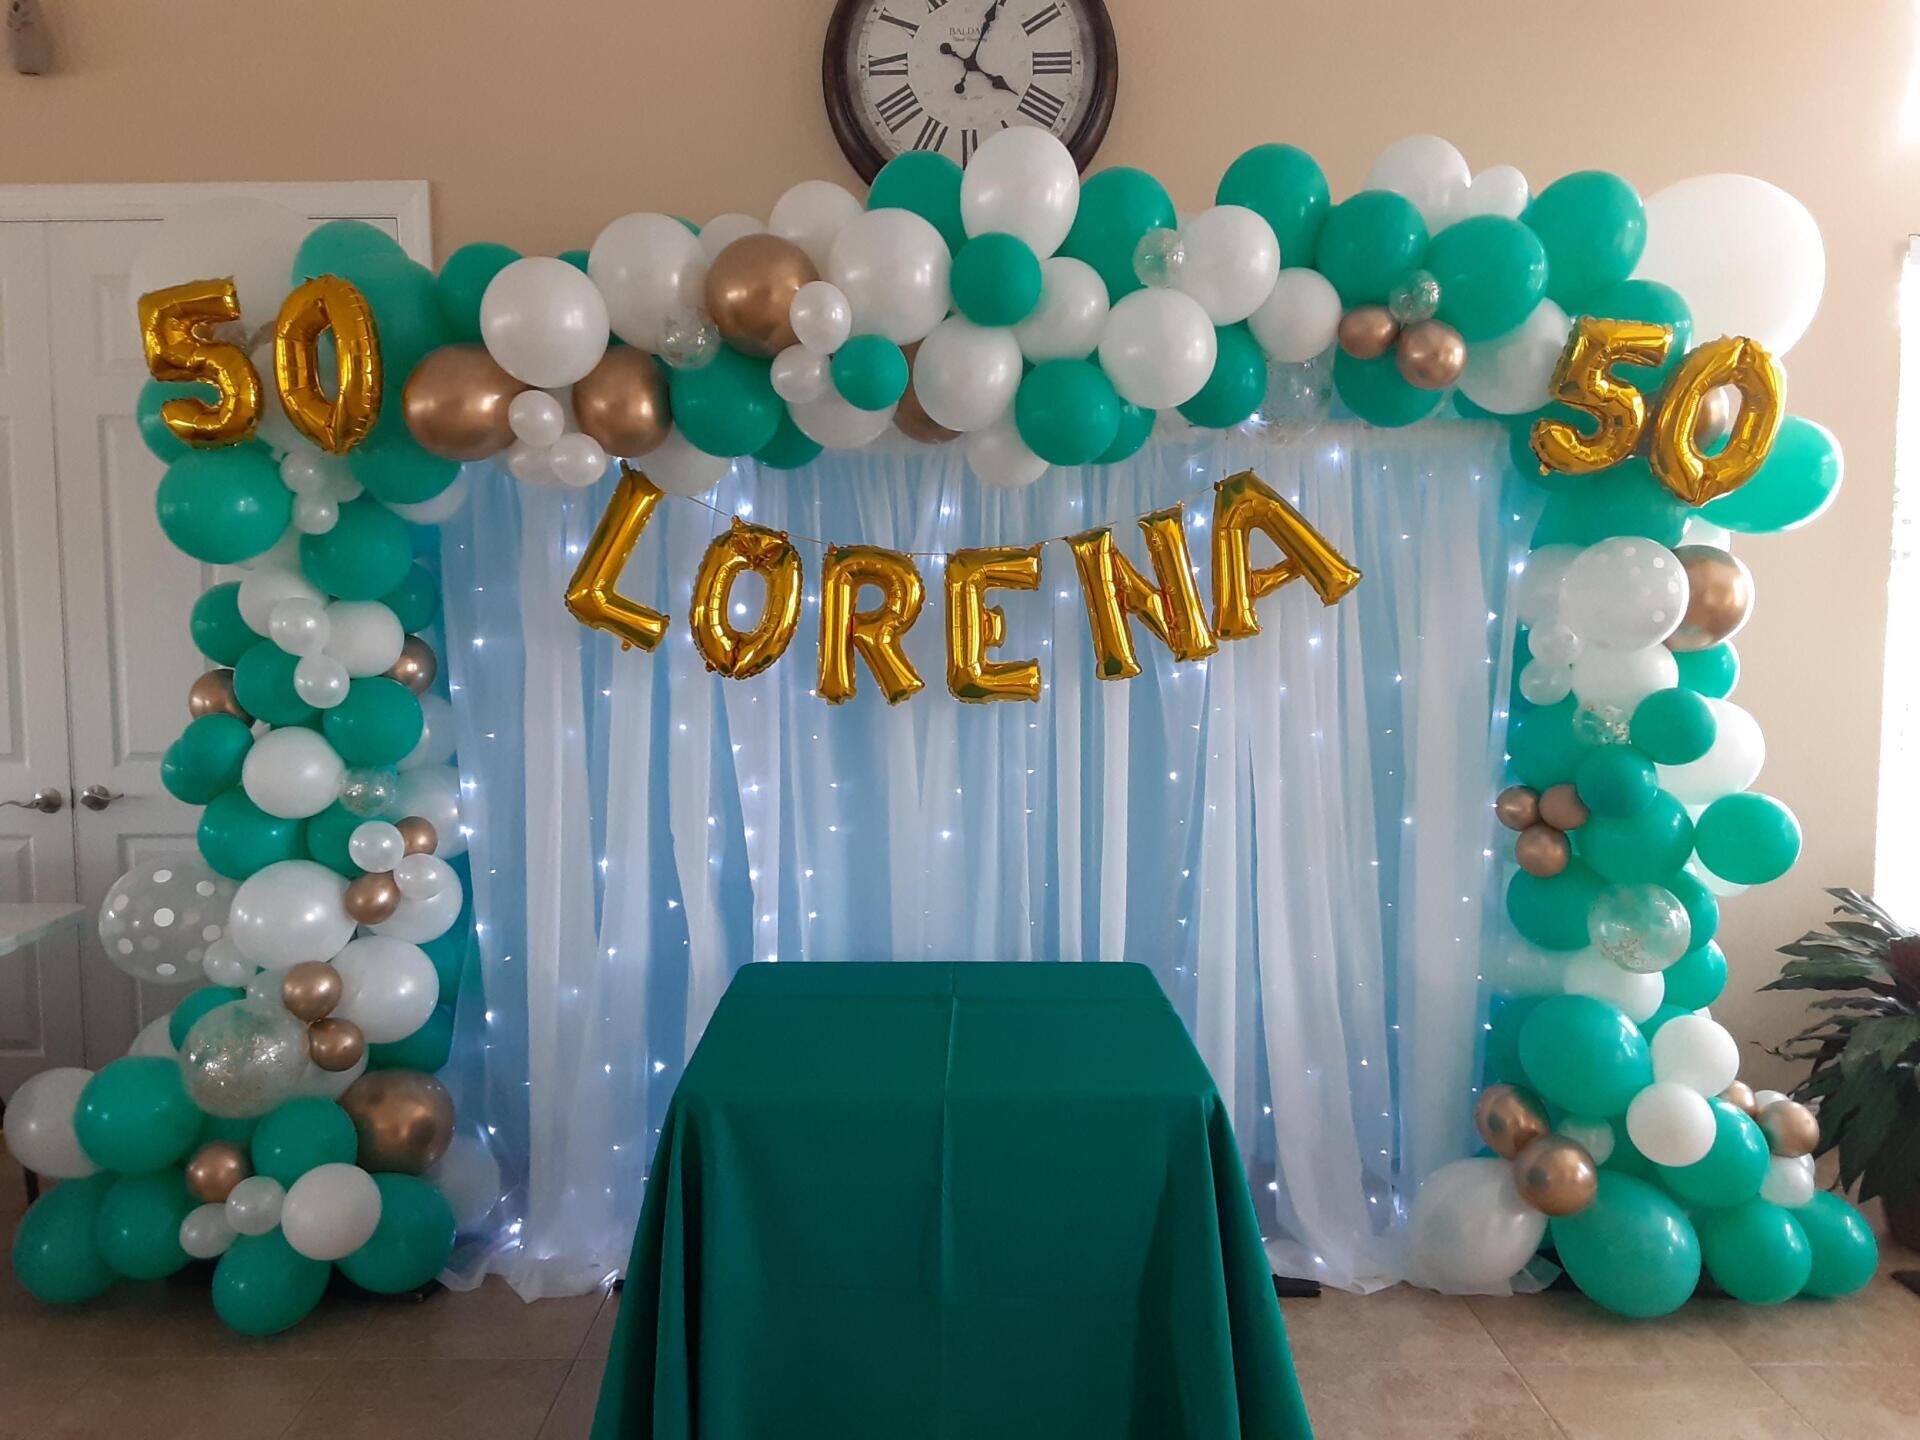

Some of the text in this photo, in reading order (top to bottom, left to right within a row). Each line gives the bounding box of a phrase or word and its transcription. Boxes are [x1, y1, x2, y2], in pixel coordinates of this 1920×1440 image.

[949, 27, 992, 36] BALDA
[1021, 3, 1061, 36] II
[868, 52, 908, 77] IX
[1032, 51, 1072, 76] III
[875, 83, 923, 134] VIII
[1017, 83, 1065, 130] IIII
[137, 274, 383, 456] 50
[1528, 316, 1787, 507] 50
[564, 466, 1362, 706] LORENA
